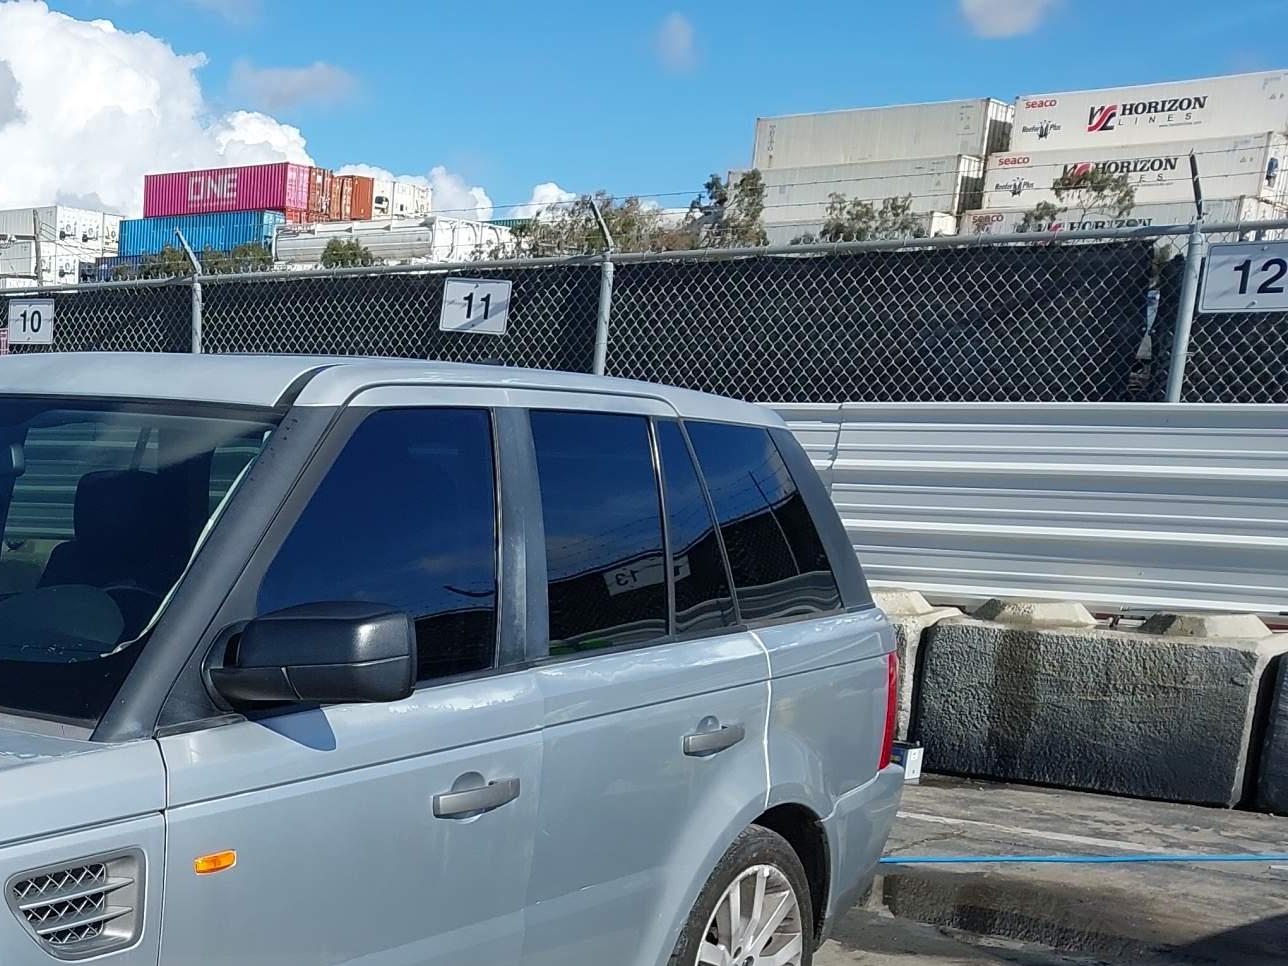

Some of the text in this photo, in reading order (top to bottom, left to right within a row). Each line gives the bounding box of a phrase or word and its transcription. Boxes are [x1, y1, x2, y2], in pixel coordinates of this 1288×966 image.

[1025, 99, 1057, 109] seaco
[1120, 96, 1208, 116] HORIZON
[1118, 113, 1192, 126] LINES
[999, 156, 1030, 166] seaco
[188, 173, 237, 201] ONE
[1233, 258, 1288, 294] 12
[464, 292, 491, 320] 11
[20, 310, 41, 332] 10
